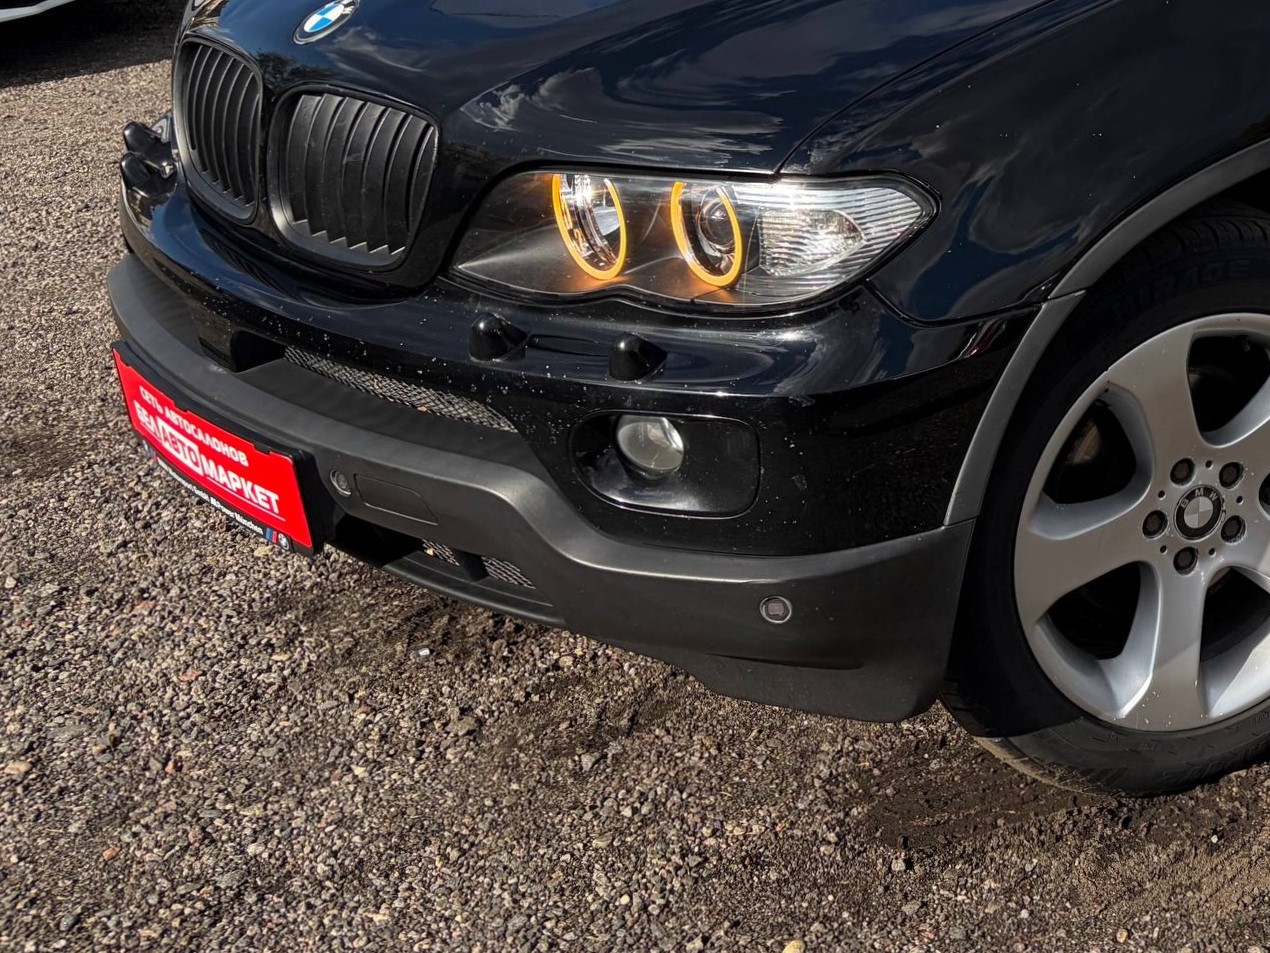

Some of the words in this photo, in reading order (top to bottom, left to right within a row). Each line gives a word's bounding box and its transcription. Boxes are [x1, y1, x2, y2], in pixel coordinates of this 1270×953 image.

[133, 399, 161, 439] БЕЛ
[160, 423, 202, 472] АВТО
[200, 454, 280, 515] МАРКЕТ
[138, 384, 164, 415] СЕТЬ
[164, 405, 250, 468] АВТОСАЛОНОВ
